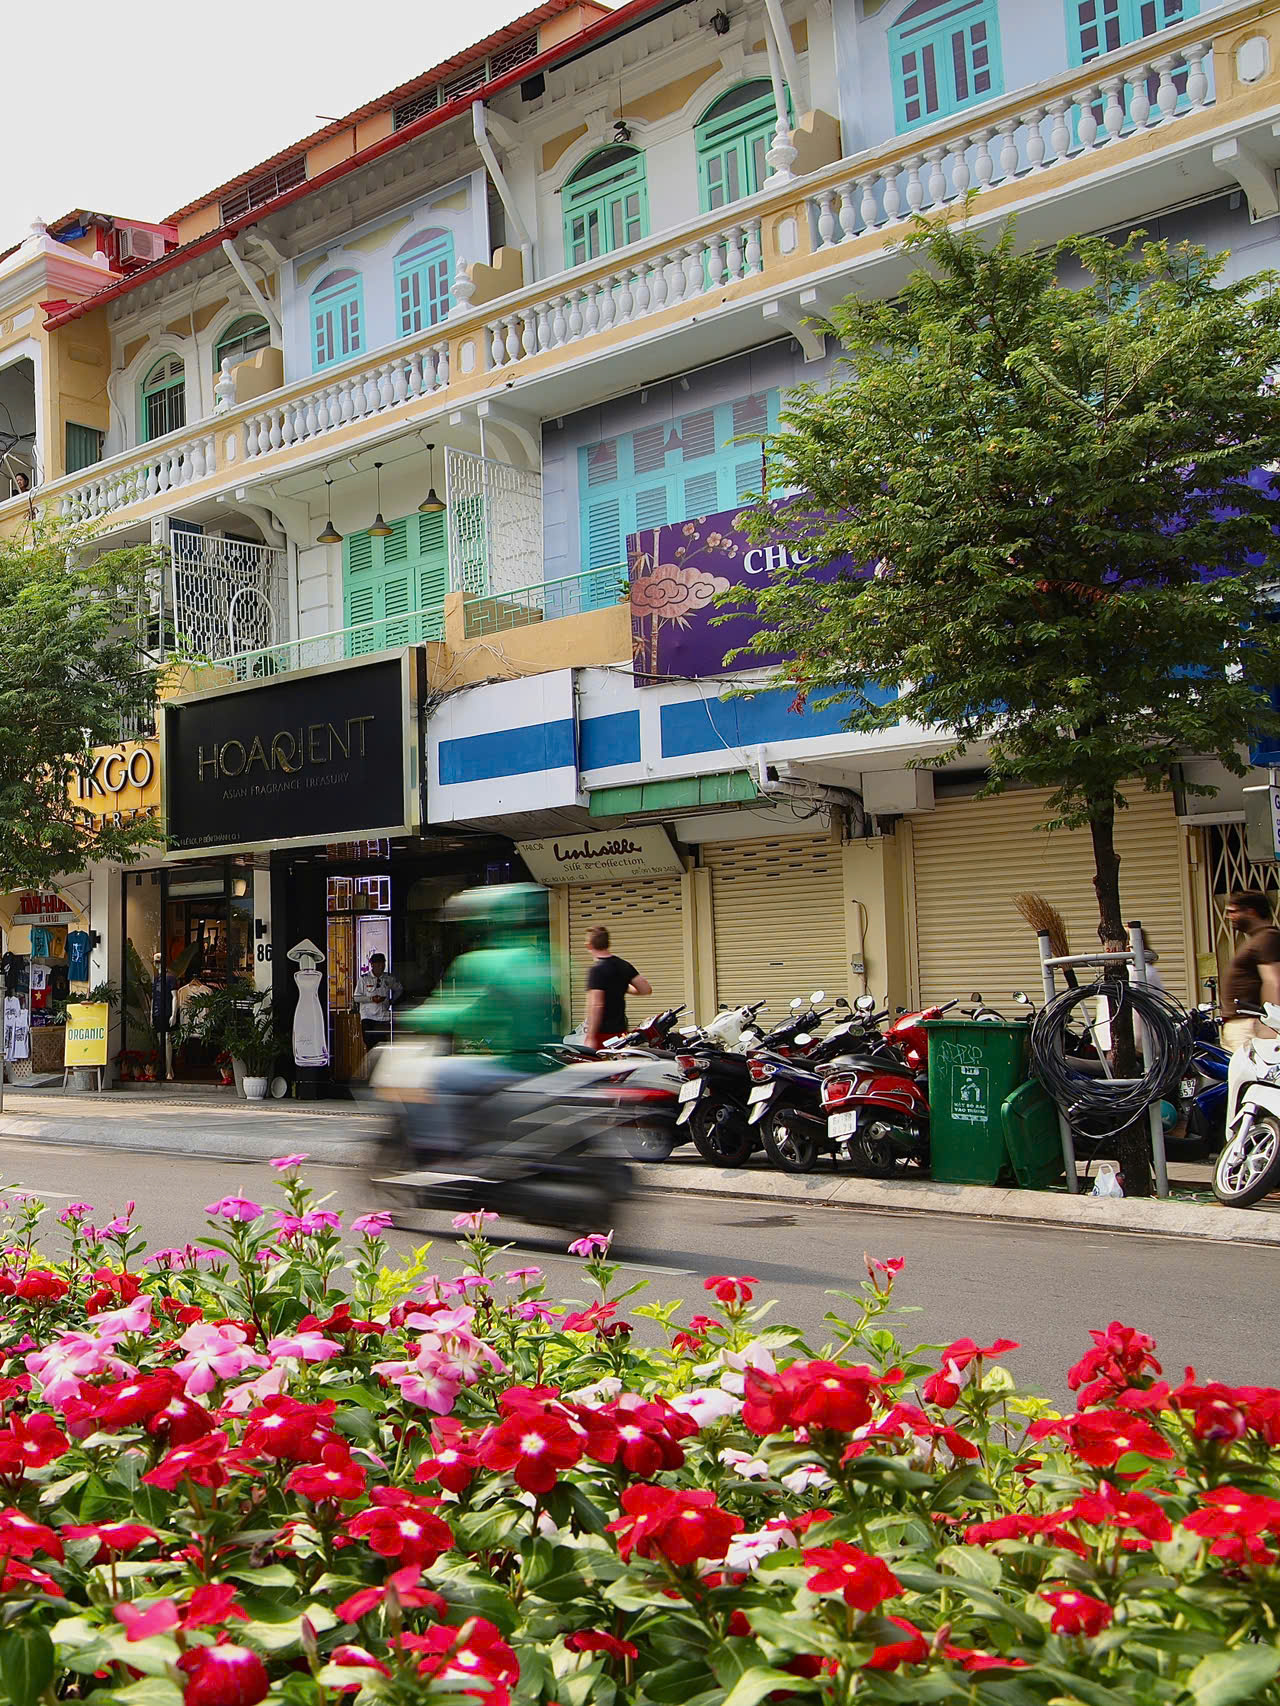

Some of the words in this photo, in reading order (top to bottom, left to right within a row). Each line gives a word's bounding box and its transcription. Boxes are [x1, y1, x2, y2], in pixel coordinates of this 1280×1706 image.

[222, 788, 248, 800] ASIAN
[250, 779, 302, 796] FRAGRANCE
[522, 843, 545, 852] TAILOR
[564, 861, 583, 872] Silk
[257, 943, 272, 962] 86
[68, 1027, 105, 1041] ORGANIC
